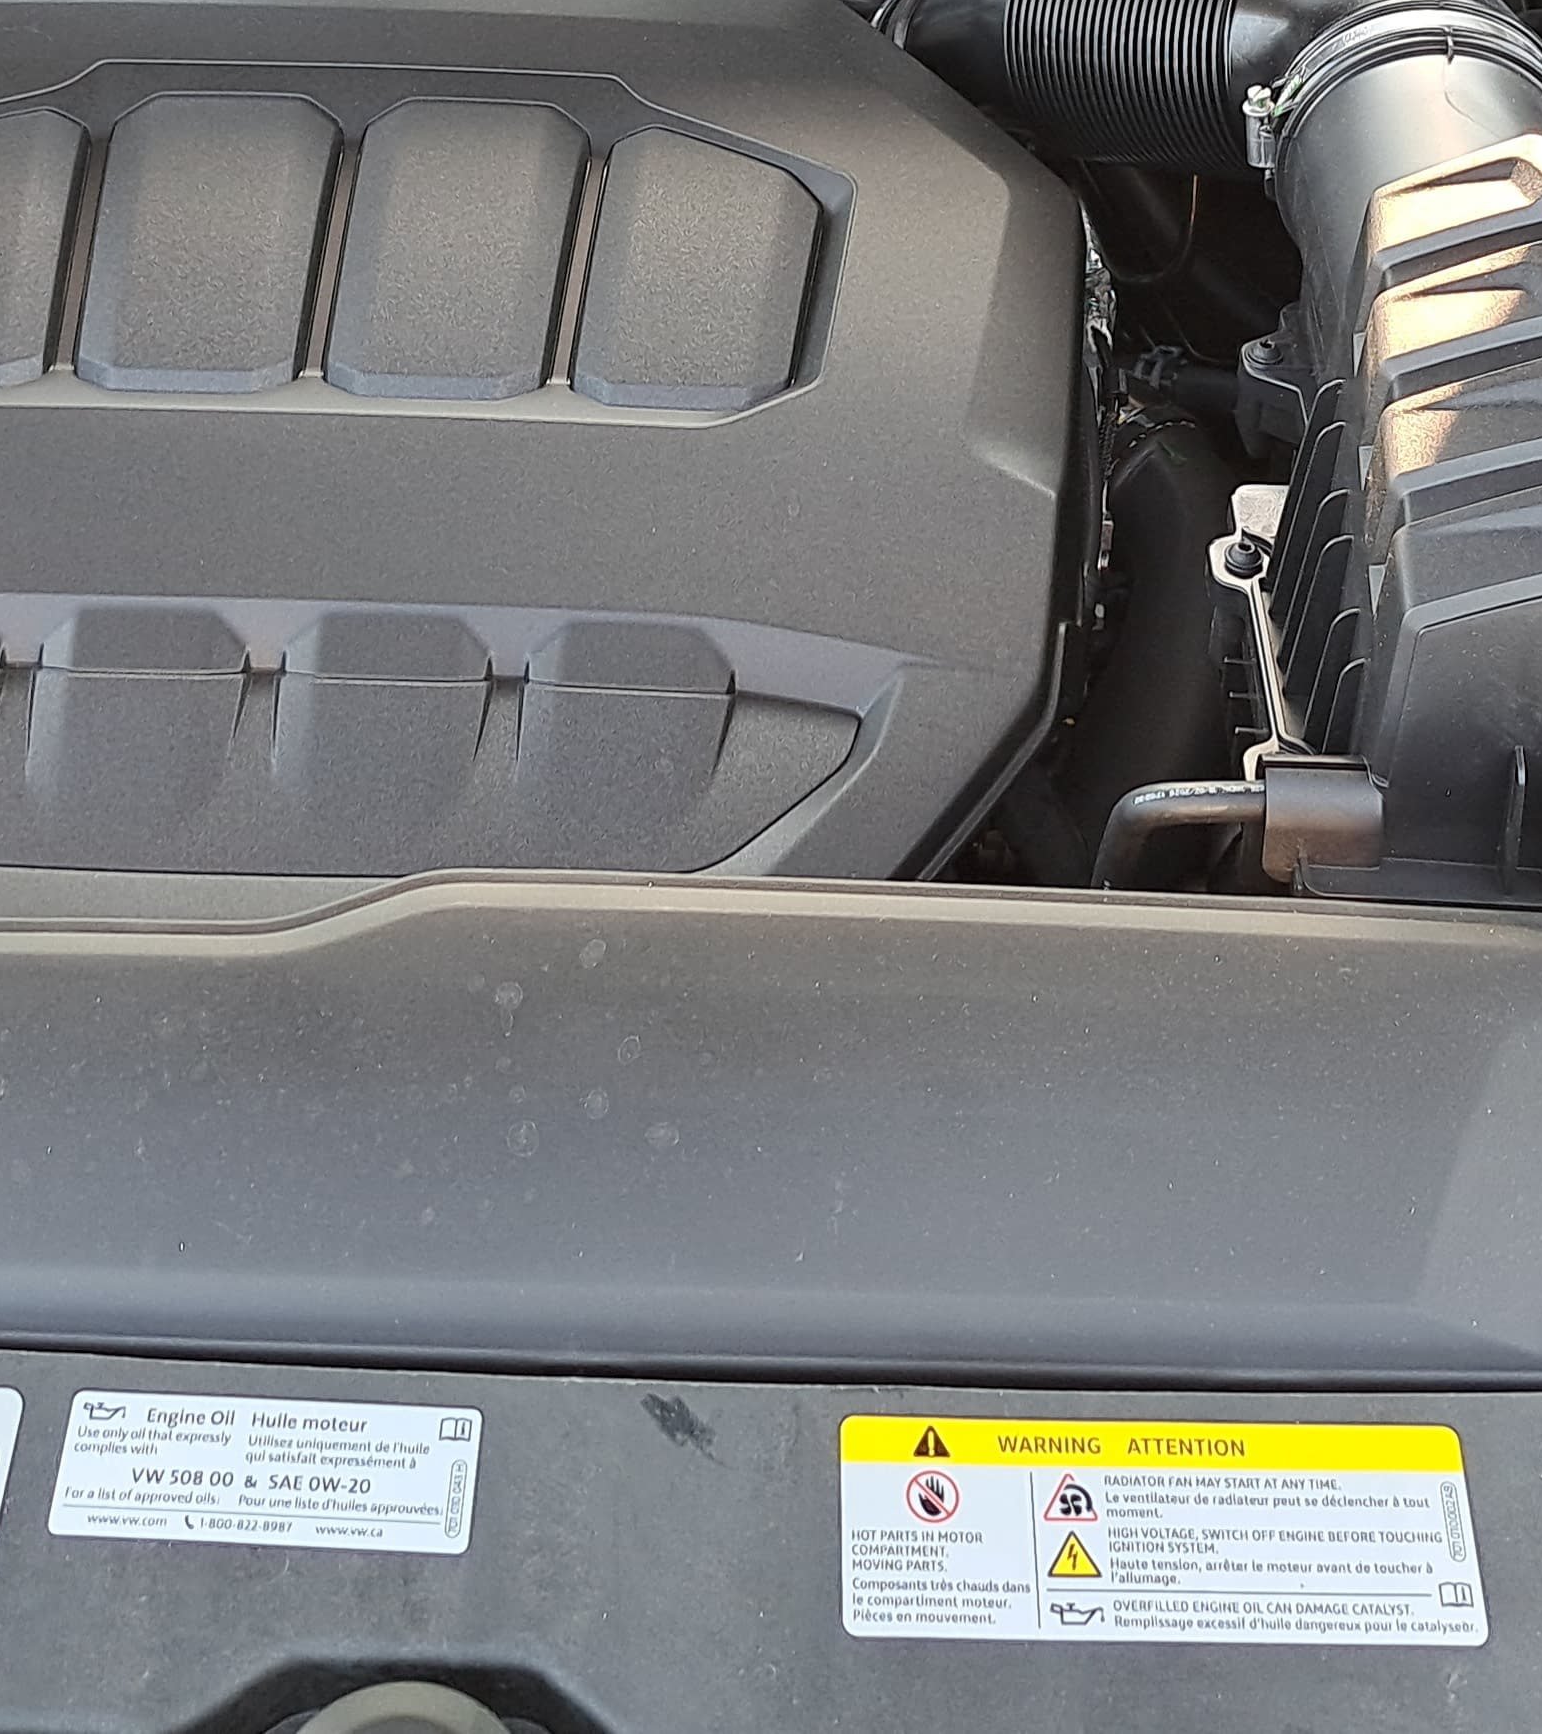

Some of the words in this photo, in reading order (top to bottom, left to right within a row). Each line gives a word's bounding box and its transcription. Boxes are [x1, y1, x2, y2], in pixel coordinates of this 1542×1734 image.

[147, 1408, 205, 1428] Engine
[211, 1410, 235, 1426] Oil
[251, 1412, 297, 1429] Huile
[302, 1416, 368, 1433] moteur
[78, 1425, 99, 1439] Use
[102, 1427, 129, 1443] only
[131, 1427, 146, 1441] oil
[148, 1429, 173, 1441] that
[175, 1430, 232, 1446] expressly
[74, 1441, 127, 1455] complies
[131, 1444, 158, 1455] with
[248, 1434, 293, 1448] Utilisez
[297, 1437, 371, 1453] uniquement
[375, 1440, 390, 1453] de
[393, 1441, 430, 1455] l'huile
[997, 1435, 1102, 1454] WARNING
[1127, 1437, 1245, 1457] ATTENTION
[245, 1451, 265, 1464] qui
[268, 1451, 317, 1465] satisfait
[320, 1455, 405, 1468] expressément
[132, 1467, 165, 1485] VW
[169, 1469, 203, 1486] 508
[209, 1471, 234, 1487] 00
[244, 1475, 257, 1489] &
[268, 1474, 303, 1491] SAE
[309, 1475, 371, 1494] 0W-20
[1104, 1475, 1165, 1487] RADIATOR
[1168, 1476, 1192, 1488] FAN
[1196, 1476, 1221, 1488] MAY
[1224, 1477, 1260, 1489] START
[1264, 1478, 1278, 1489] AT
[1281, 1478, 1305, 1490] ANY
[1308, 1478, 1342, 1491] TIME.
[65, 1486, 84, 1498] For
[98, 1487, 115, 1500] list
[119, 1488, 133, 1501] of
[134, 1491, 194, 1505] approved
[238, 1494, 266, 1507] Pour
[269, 1498, 292, 1508] une
[294, 1496, 319, 1510] liste
[322, 1496, 368, 1513] d'huiles
[1105, 1492, 1120, 1503] Le
[1123, 1491, 1190, 1505] ventilateur
[1194, 1493, 1209, 1505] de
[1213, 1494, 1269, 1506] radiateur
[1273, 1496, 1301, 1509] peut
[1304, 1498, 1318, 1507] se
[1321, 1496, 1389, 1508] déclencher
[1403, 1497, 1430, 1508] tout
[1106, 1508, 1163, 1518] moment.
[87, 1514, 167, 1527] www.vw.com
[315, 1525, 384, 1538] www.vw.ca
[851, 1530, 877, 1541] HOT
[880, 1530, 918, 1542] PARTS
[921, 1531, 934, 1542] IN
[938, 1531, 983, 1543] MOTOR
[1108, 1527, 1138, 1539] HIGH
[1141, 1527, 1199, 1541] VOLTAGE,
[1201, 1529, 1249, 1541] SWITCH
[1252, 1529, 1276, 1542] OFF
[1279, 1530, 1325, 1542] ENGINE
[1328, 1531, 1376, 1543] BEFORE
[1380, 1532, 1442, 1543] TOUCHING
[851, 1544, 949, 1558] COMPARTMENT.
[1109, 1542, 1165, 1553] IGNITION
[1167, 1543, 1219, 1555] SYSTEM.
[852, 1559, 903, 1571] MOVING
[906, 1560, 947, 1573] PARTS.
[1110, 1558, 1148, 1570] Haute
[1151, 1559, 1202, 1573] tension,
[1205, 1558, 1247, 1572] arrêter
[1252, 1559, 1263, 1571] le
[1267, 1563, 1313, 1574] moteur
[1317, 1563, 1351, 1574] avant
[1355, 1562, 1371, 1574] de
[1374, 1563, 1422, 1574] toucher
[852, 1577, 927, 1592] Composants
[930, 1579, 953, 1591] très
[956, 1579, 999, 1593] chauds
[1002, 1581, 1031, 1594] dans
[852, 1593, 864, 1605] le
[867, 1595, 958, 1608] compartiment
[1113, 1600, 1189, 1612] OVERFILLED
[1193, 1601, 1239, 1614] ENGINE
[1243, 1602, 1264, 1614] OIL
[1266, 1603, 1291, 1614] CAN
[1296, 1603, 1348, 1615] DAMAGE
[1352, 1603, 1415, 1616] CATALYST.
[853, 1609, 893, 1622] Pièces
[896, 1612, 912, 1622] en
[916, 1612, 996, 1624] mouvement.
[1114, 1616, 1194, 1631] Remplissage
[1197, 1617, 1246, 1630] excessif
[1249, 1618, 1291, 1630] d'huile
[1295, 1619, 1361, 1634] dangereux
[1364, 1621, 1392, 1633] pour
[1396, 1620, 1407, 1632] le
